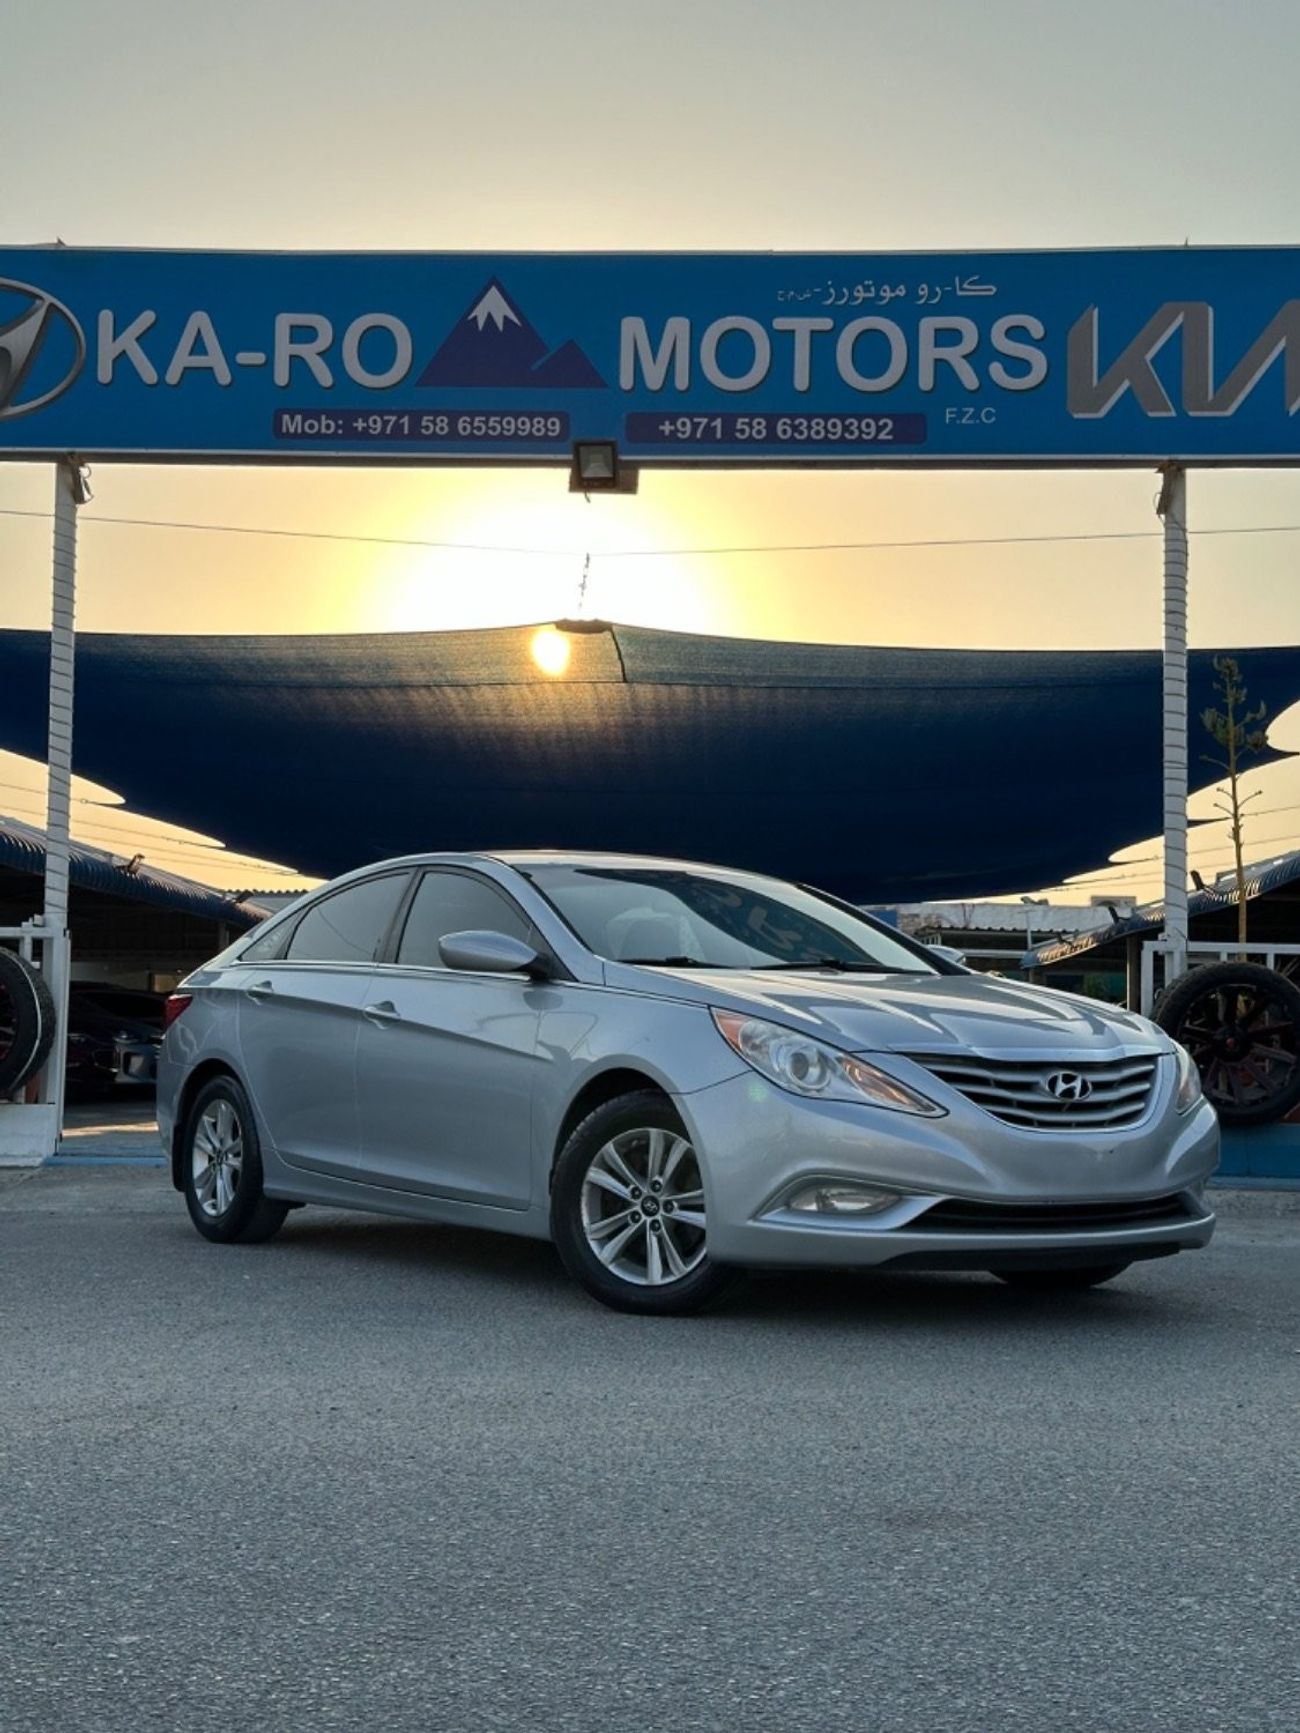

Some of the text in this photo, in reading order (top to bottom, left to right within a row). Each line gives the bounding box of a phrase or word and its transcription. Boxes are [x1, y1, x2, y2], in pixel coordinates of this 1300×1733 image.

[97, 309, 1047, 393] KA-RO MOTORS
[281, 413, 562, 437] Mob: +971 58 6559989
[944, 407, 997, 425] F.Z.C
[658, 418, 894, 440] +971 58 6389392
